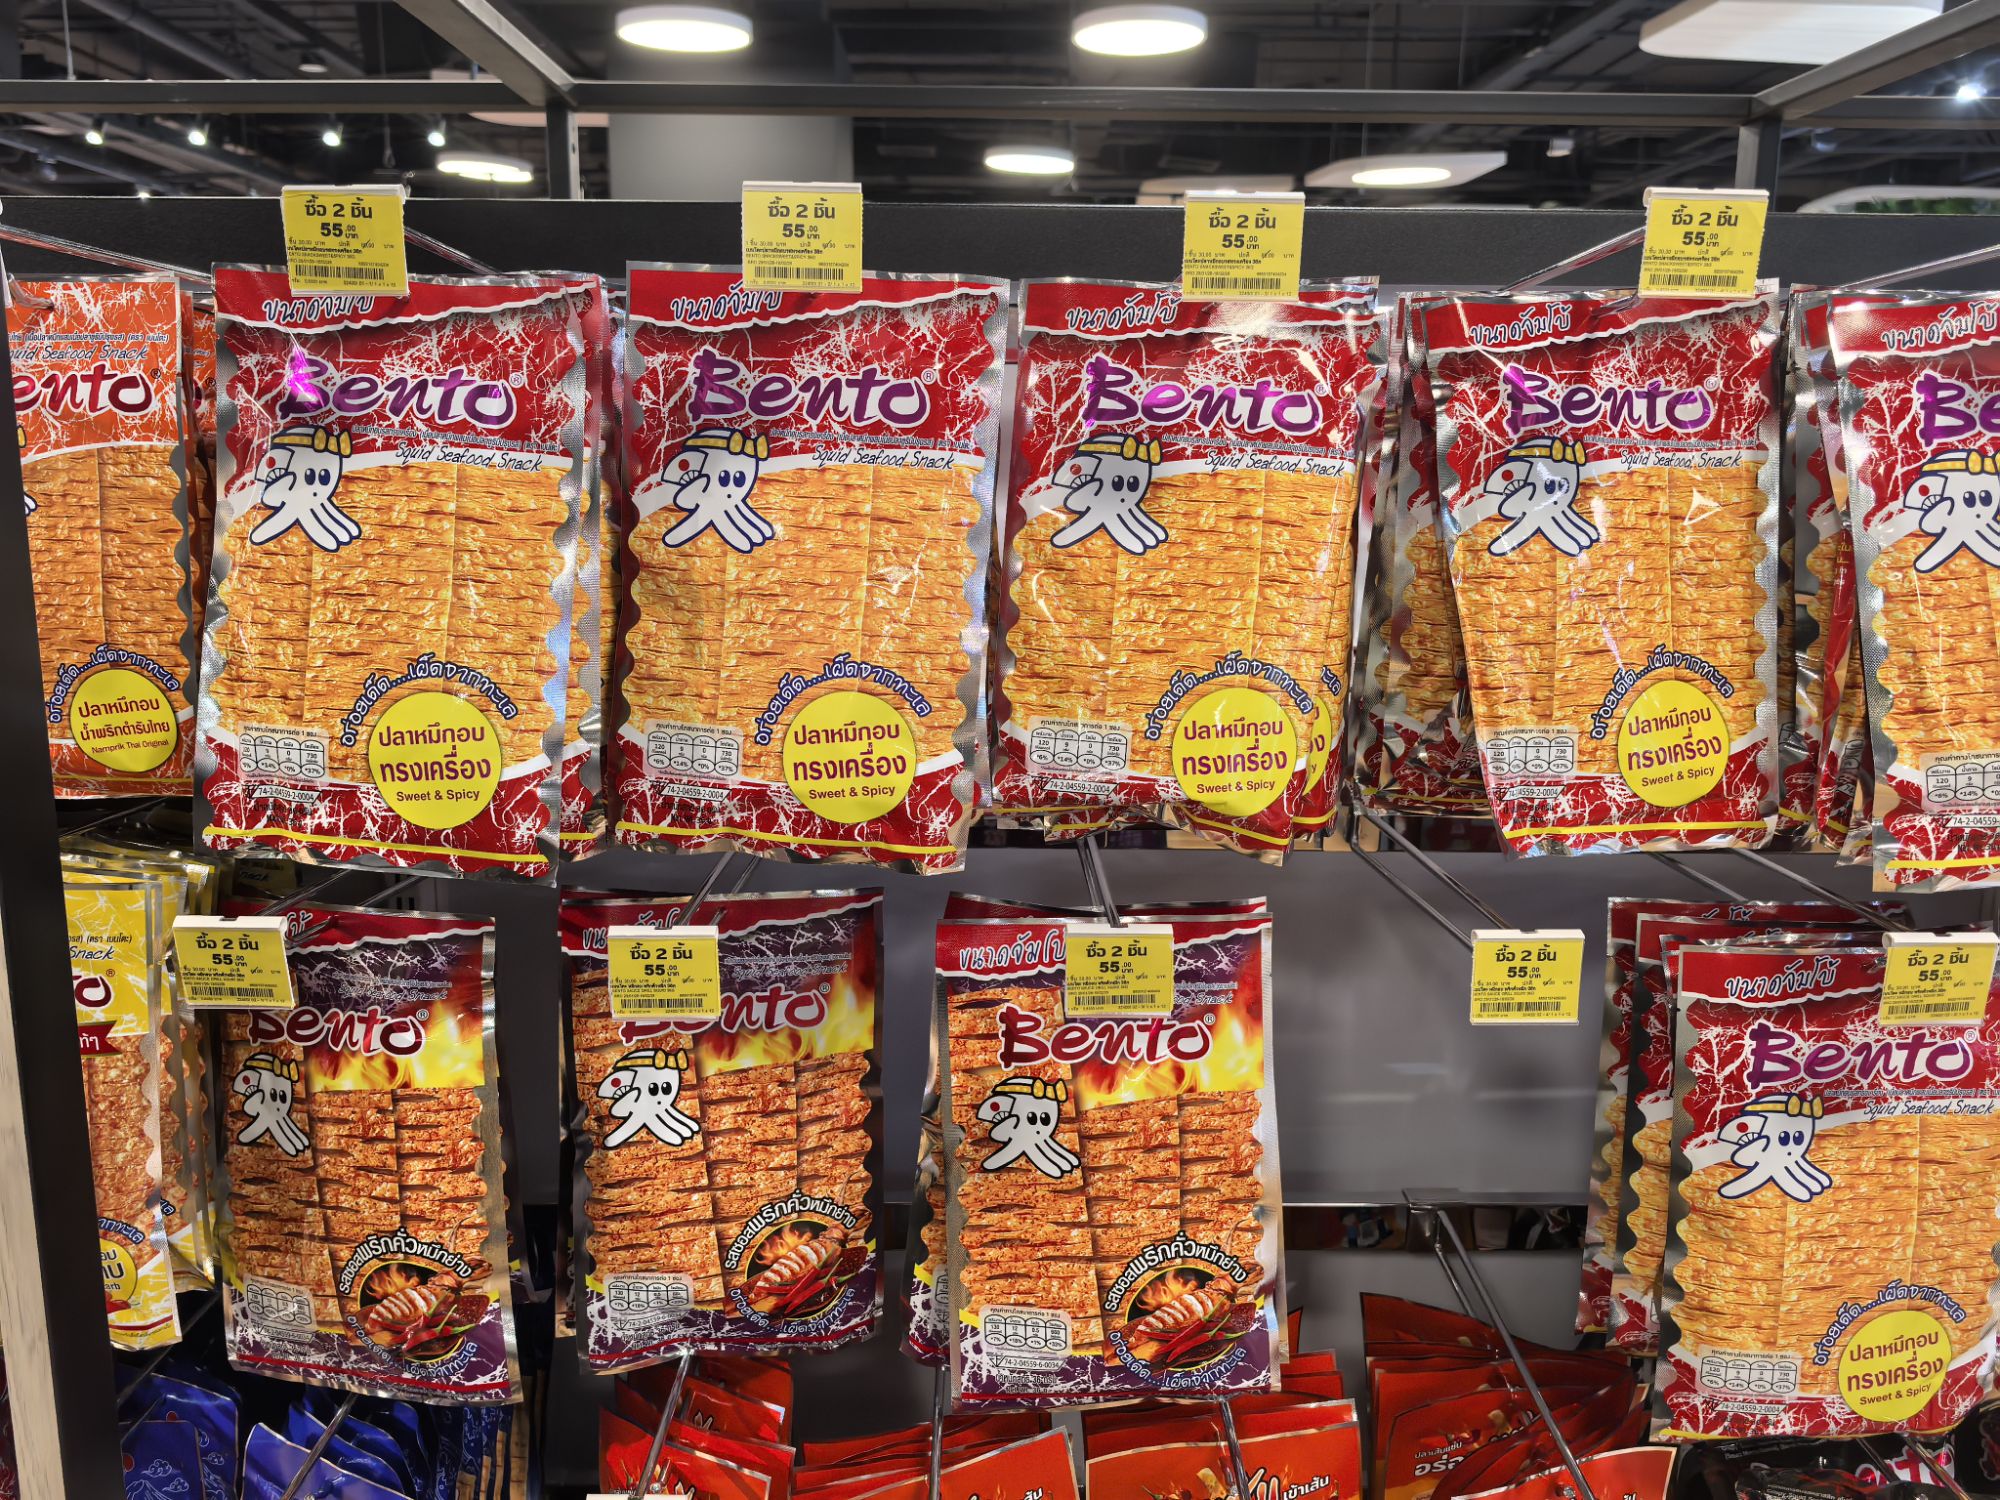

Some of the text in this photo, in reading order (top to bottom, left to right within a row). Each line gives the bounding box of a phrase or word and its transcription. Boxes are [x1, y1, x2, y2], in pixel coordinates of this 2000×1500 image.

[305, 195, 372, 218] ซื้อ 2 ชิ้น
[768, 196, 835, 219] ซื้อ 2 ชิ้น
[1672, 205, 1738, 226] ซื้อ 2 ชิ้น
[1209, 207, 1276, 229] ซื้อ 2 ชิ้น
[321, 223, 343, 236] 55
[783, 224, 805, 237] 55
[1682, 232, 1705, 245] 55
[1222, 234, 1244, 248] 55
[1469, 303, 1573, 346] ขนาดจัมโบ้
[1881, 302, 1999, 349] ขนาดจัมโบ้
[42, 343, 147, 360] Seafood Snack
[14, 362, 153, 415] ento
[277, 354, 516, 428] Bento
[686, 346, 930, 427] Bento
[1082, 353, 1324, 434] Bento
[1500, 363, 1715, 438] Bento
[396, 442, 541, 472] Squid Seafood Snack
[812, 444, 955, 470] Squid Seafood Snack
[1204, 449, 1346, 478] Squid Seafood Snack
[1620, 450, 1743, 469] Squid Seafood Snack
[78, 696, 160, 718] ปลาหมึกอบ
[80, 720, 170, 741] น้ำพริกตำรับไทย
[1184, 717, 1283, 740] ปลาหมึกอบ
[1628, 707, 1712, 736] ปลาหมึกอบ
[379, 722, 485, 746] ปลาหมึกอบ
[794, 721, 900, 745] ปลาหมึกอบ
[92, 743, 125, 754] Namprik
[143, 739, 169, 750] Original
[1182, 738, 1288, 776] ทรงเครื่อง
[1628, 727, 1722, 770] ทรงเครื่อง
[380, 745, 491, 782] ทรงเครื่อง
[794, 742, 907, 781] ทรงเครื่อง
[1050, 780, 1110, 792] 74-2-04559-2-0004
[1197, 780, 1275, 794] Sweet & Spicy
[1642, 766, 1715, 787] Sweet & Spicy
[397, 789, 480, 802] Sweet & Spicy
[667, 786, 724, 798] 74-2-04559-2-0004
[809, 785, 895, 799] Sweet & Spicy
[196, 932, 259, 950] ซื้อ 2 ชิ้น
[630, 943, 692, 959] ซื้อ 2 ชิ้น
[1086, 940, 1147, 957] ซื้อ 2 ชิ้น
[70, 945, 115, 960] Snack
[213, 954, 233, 965] 55
[1496, 944, 1556, 962] ซื้อ 2 ชิ้น
[1908, 947, 1969, 966] ซื้อ 2 ชิ้น
[645, 965, 665, 975] 55
[1100, 962, 1119, 972] 55
[1508, 967, 1527, 978] 55
[1725, 956, 1841, 998] ขนาดจัมโบ้
[1919, 970, 1939, 981] 55
[409, 989, 447, 1001] Snack
[1195, 993, 1233, 1005] Snack
[996, 1003, 1214, 1072] Bento
[1746, 1019, 1974, 1091] Bento
[1863, 1100, 1995, 1121] Squid Seafood Snack
[1850, 1332, 1938, 1362] ปลาหมึกอบ
[1004, 1360, 1059, 1368] 74-2-04559-6-0034
[1847, 1351, 1944, 1392] ทรงเครื่อง
[1860, 1383, 1932, 1405] Sweet & Spicy
[1721, 1402, 1780, 1413] 74-2-04559-2-0004
